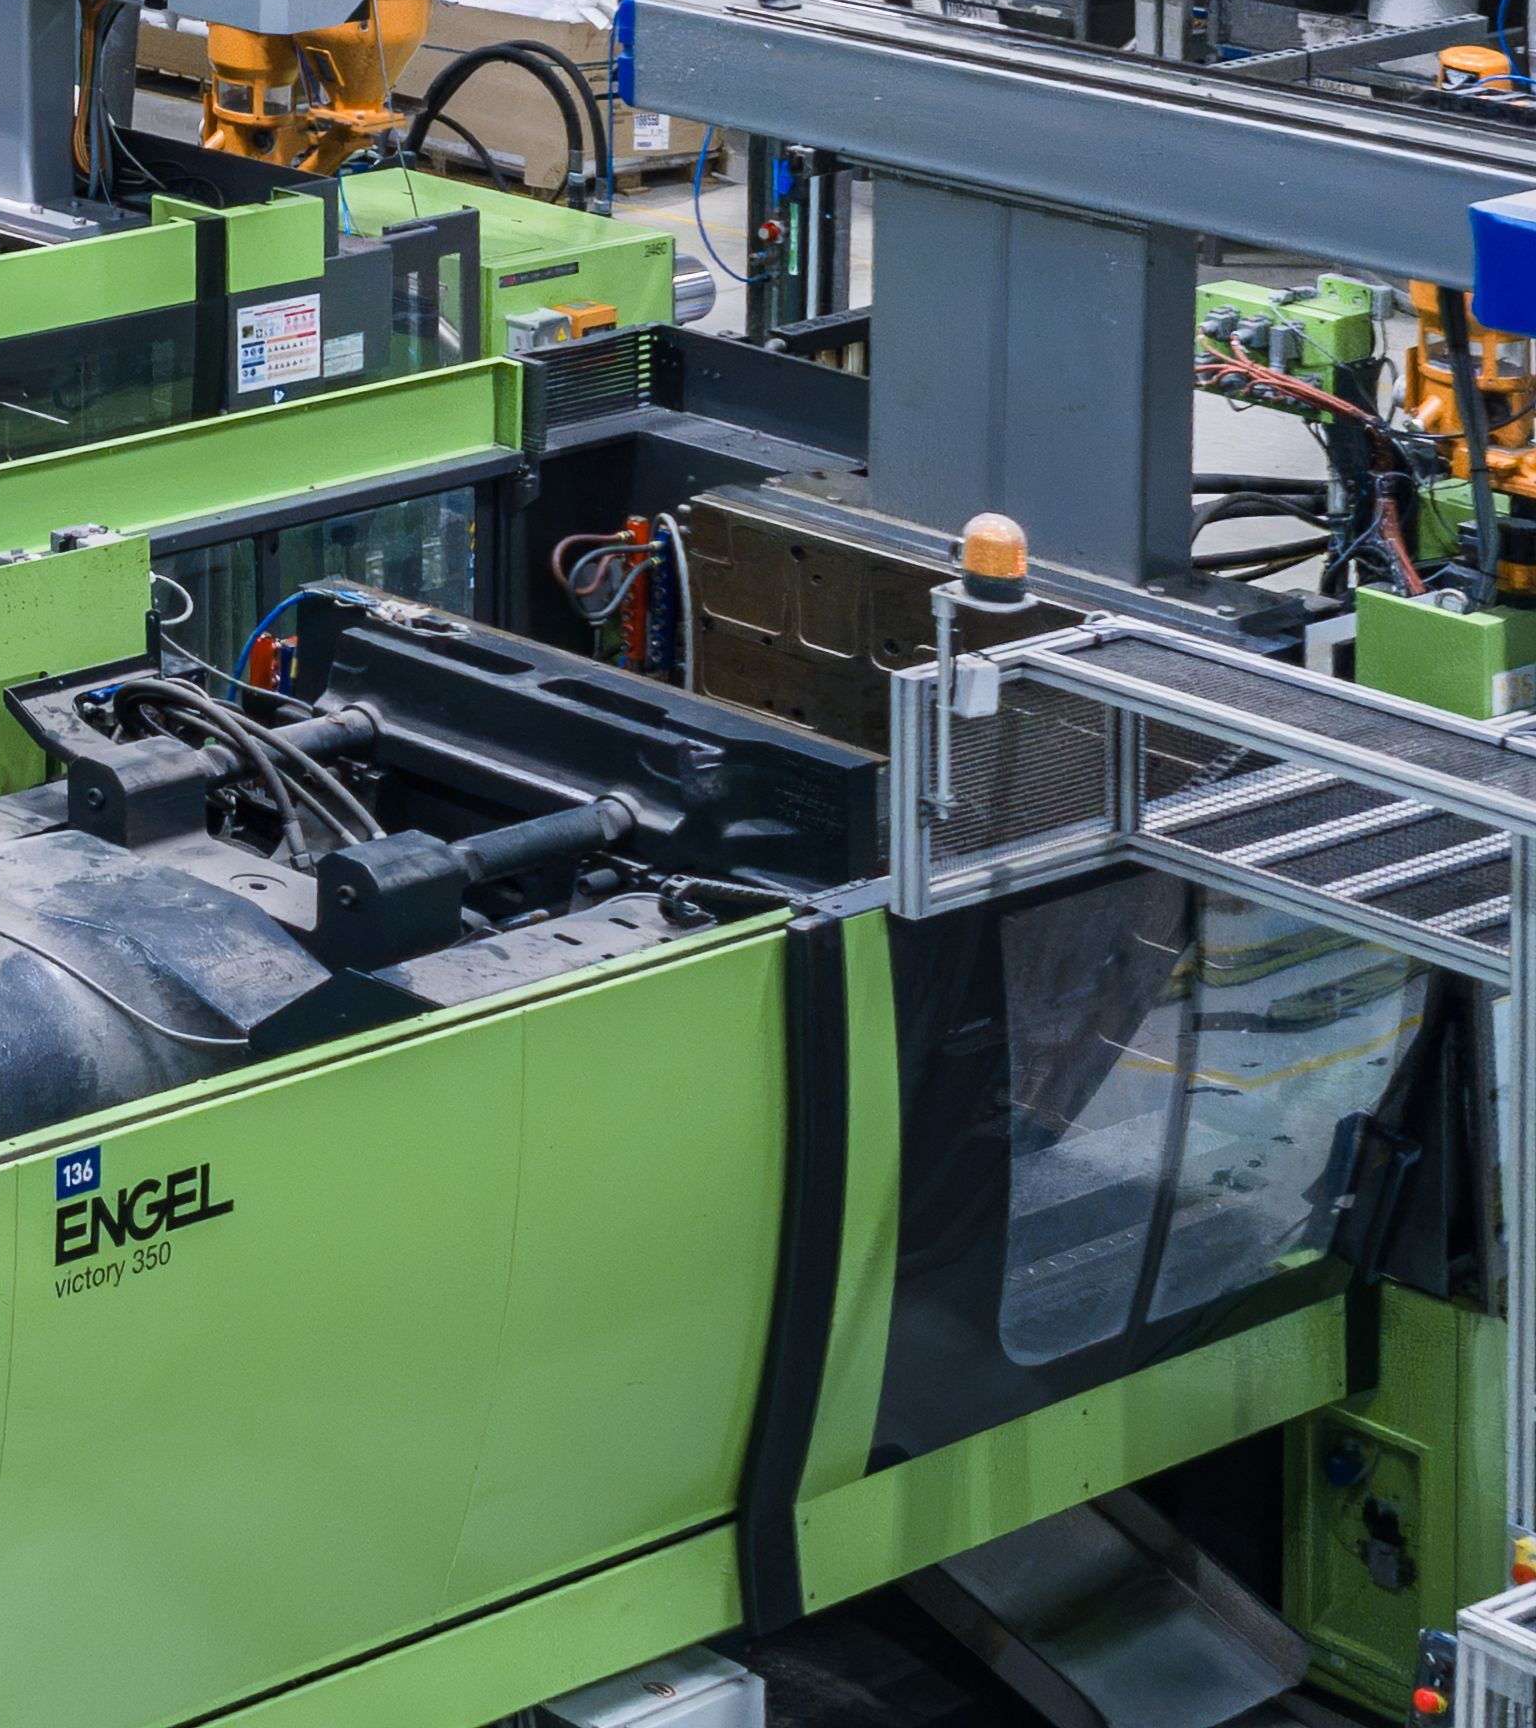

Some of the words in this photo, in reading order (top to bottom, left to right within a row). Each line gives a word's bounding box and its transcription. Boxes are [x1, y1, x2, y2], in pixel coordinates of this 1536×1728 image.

[63, 1158, 93, 1188] 136
[55, 1162, 234, 1267] ENGEL
[55, 1257, 126, 1300] victory
[132, 1240, 172, 1274] 350
